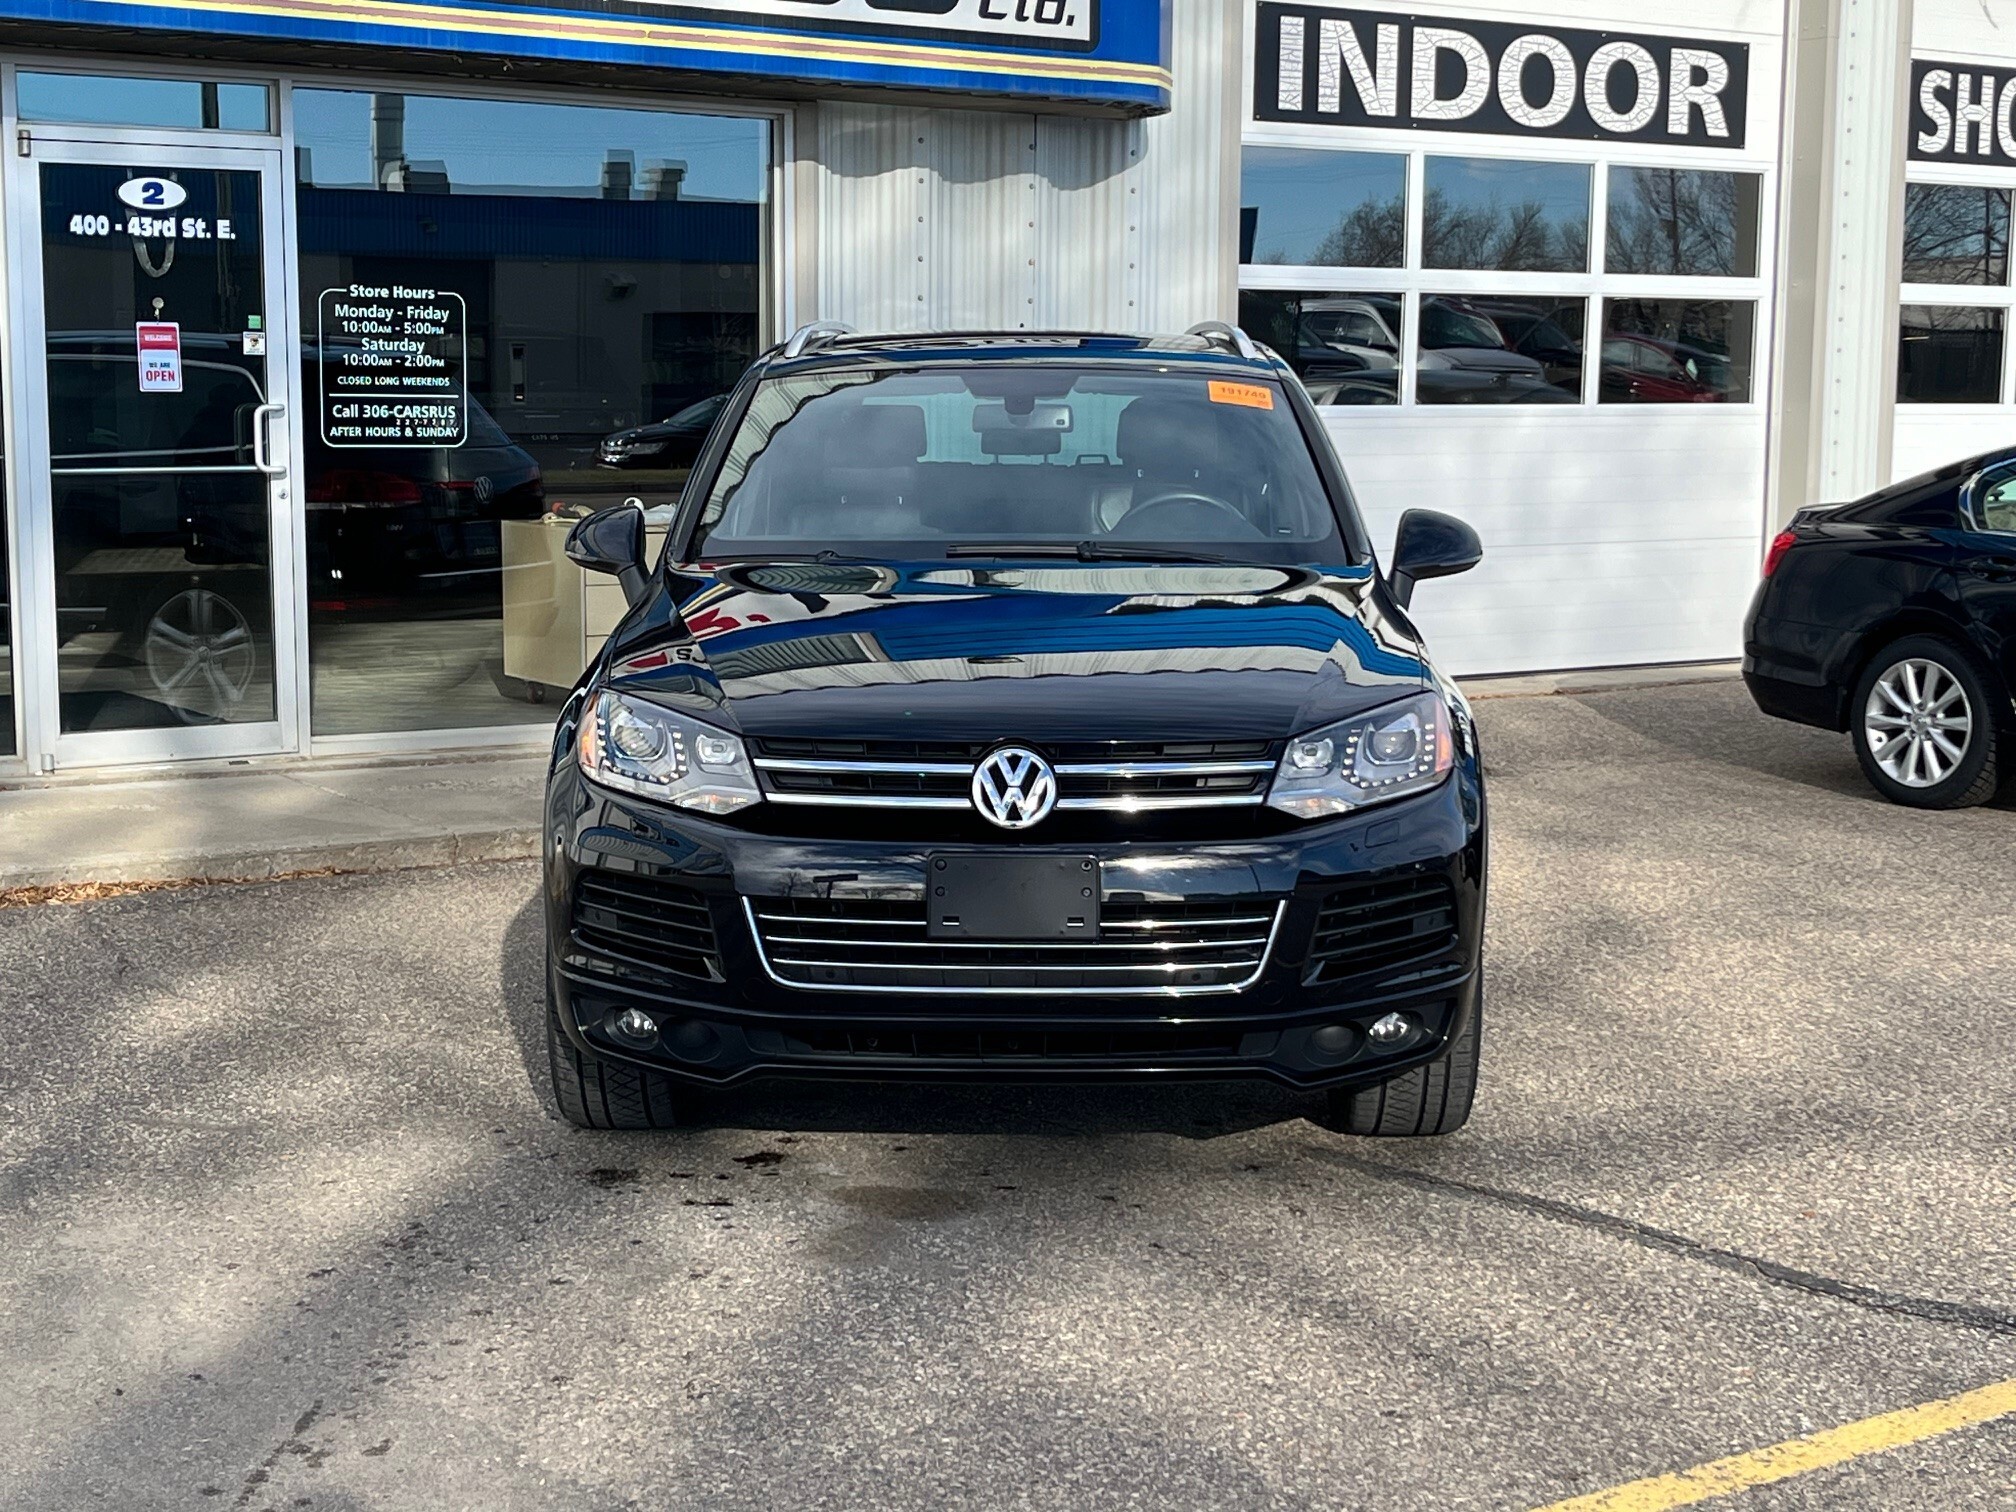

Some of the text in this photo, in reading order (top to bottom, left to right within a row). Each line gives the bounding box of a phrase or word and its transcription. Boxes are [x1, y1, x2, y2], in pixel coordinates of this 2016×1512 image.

[1277, 14, 1730, 138] INDOOR
[141, 181, 165, 205] 2
[69, 214, 110, 236] 400
[127, 216, 177, 238] 43rd
[182, 217, 212, 239] St.
[216, 218, 236, 240] E.
[350, 284, 436, 299] Store Hours
[334, 304, 394, 322] Monday
[406, 305, 450, 323] Friday
[342, 320, 392, 334] 10:00AM
[403, 321, 444, 335] 5:00PM
[361, 337, 426, 355] Saturday
[342, 353, 393, 366] 10:00AM
[404, 354, 445, 367] 2:00PM
[145, 370, 176, 382] OPEN
[337, 376, 450, 387] CLOSED LONG WEEKENDS
[332, 403, 456, 419] Call 306-CARSRUS
[329, 426, 459, 438] AFTER HOURS & SUNDAY
[977, 751, 1052, 826] VW
